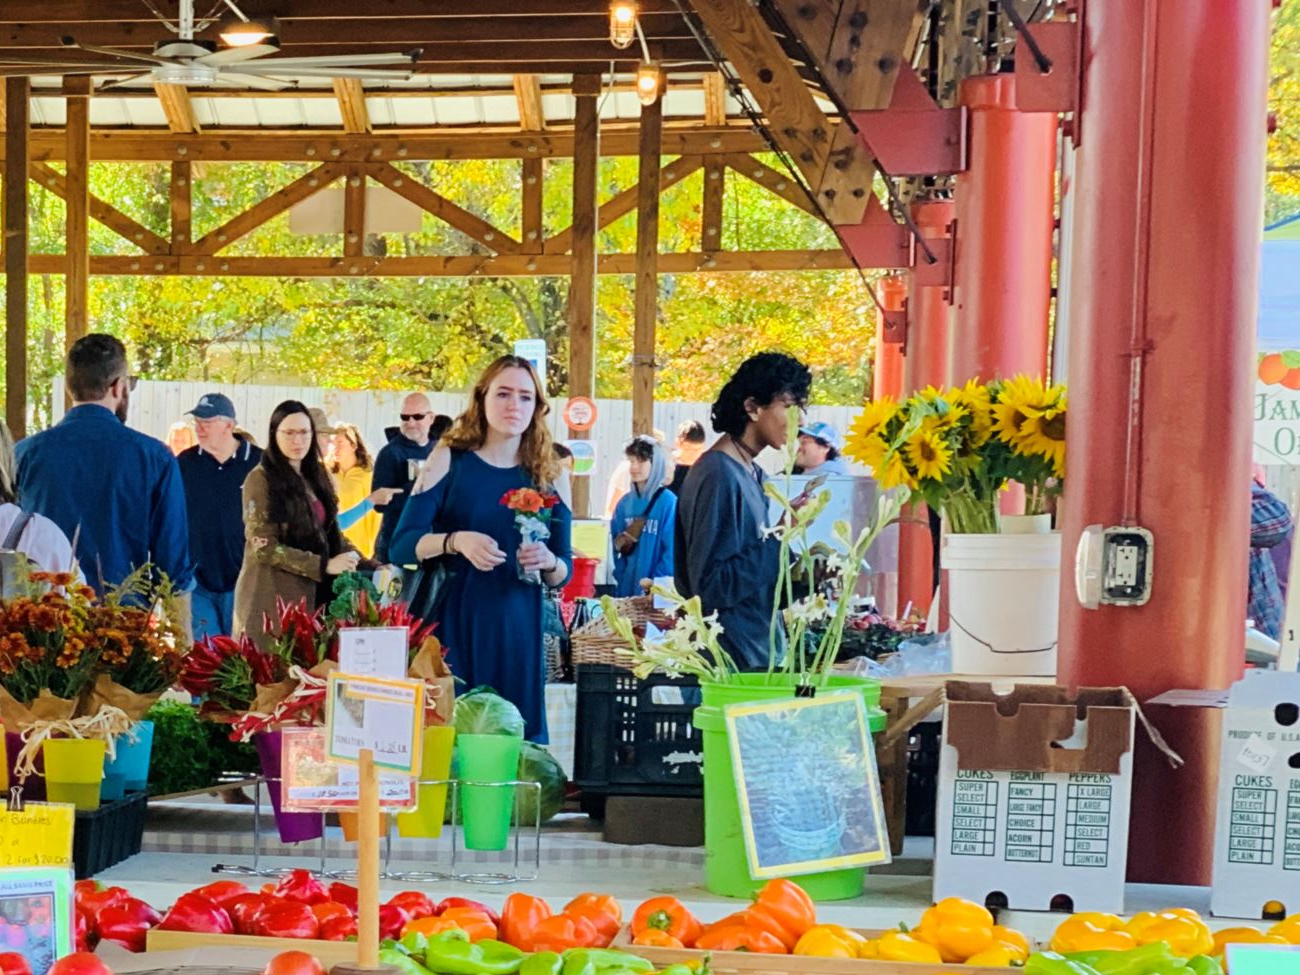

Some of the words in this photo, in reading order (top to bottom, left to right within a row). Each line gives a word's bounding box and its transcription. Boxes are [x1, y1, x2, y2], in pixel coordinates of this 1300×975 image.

[1274, 426, 1300, 456] O
[957, 768, 994, 779] CUKES
[1069, 773, 1112, 783] PEPPERS
[1235, 774, 1273, 787] CUKES
[959, 782, 983, 792] SUPER
[1010, 787, 1033, 796] FANCY
[1087, 788, 1109, 797] LARGE
[1237, 790, 1262, 799] SUPER
[957, 793, 984, 802] SELECT
[1080, 801, 1101, 810] LARGE
[1235, 801, 1263, 810] SELECT
[956, 806, 981, 815] SMALL
[1078, 815, 1107, 823] MEDIUM
[1234, 813, 1260, 822] SMALL
[955, 818, 982, 827] SELECT
[1009, 819, 1035, 828] CHOICE
[1077, 828, 1103, 837] SELECT
[1233, 826, 1262, 835] SELECT
[954, 831, 979, 840] LARGE
[1008, 834, 1033, 843] ACORN
[954, 843, 977, 852] PLAIN
[1077, 841, 1091, 850] RED
[1232, 839, 1257, 848] LARGE
[1076, 855, 1104, 864] SUNTAN
[1231, 851, 1254, 860] PLAIN
